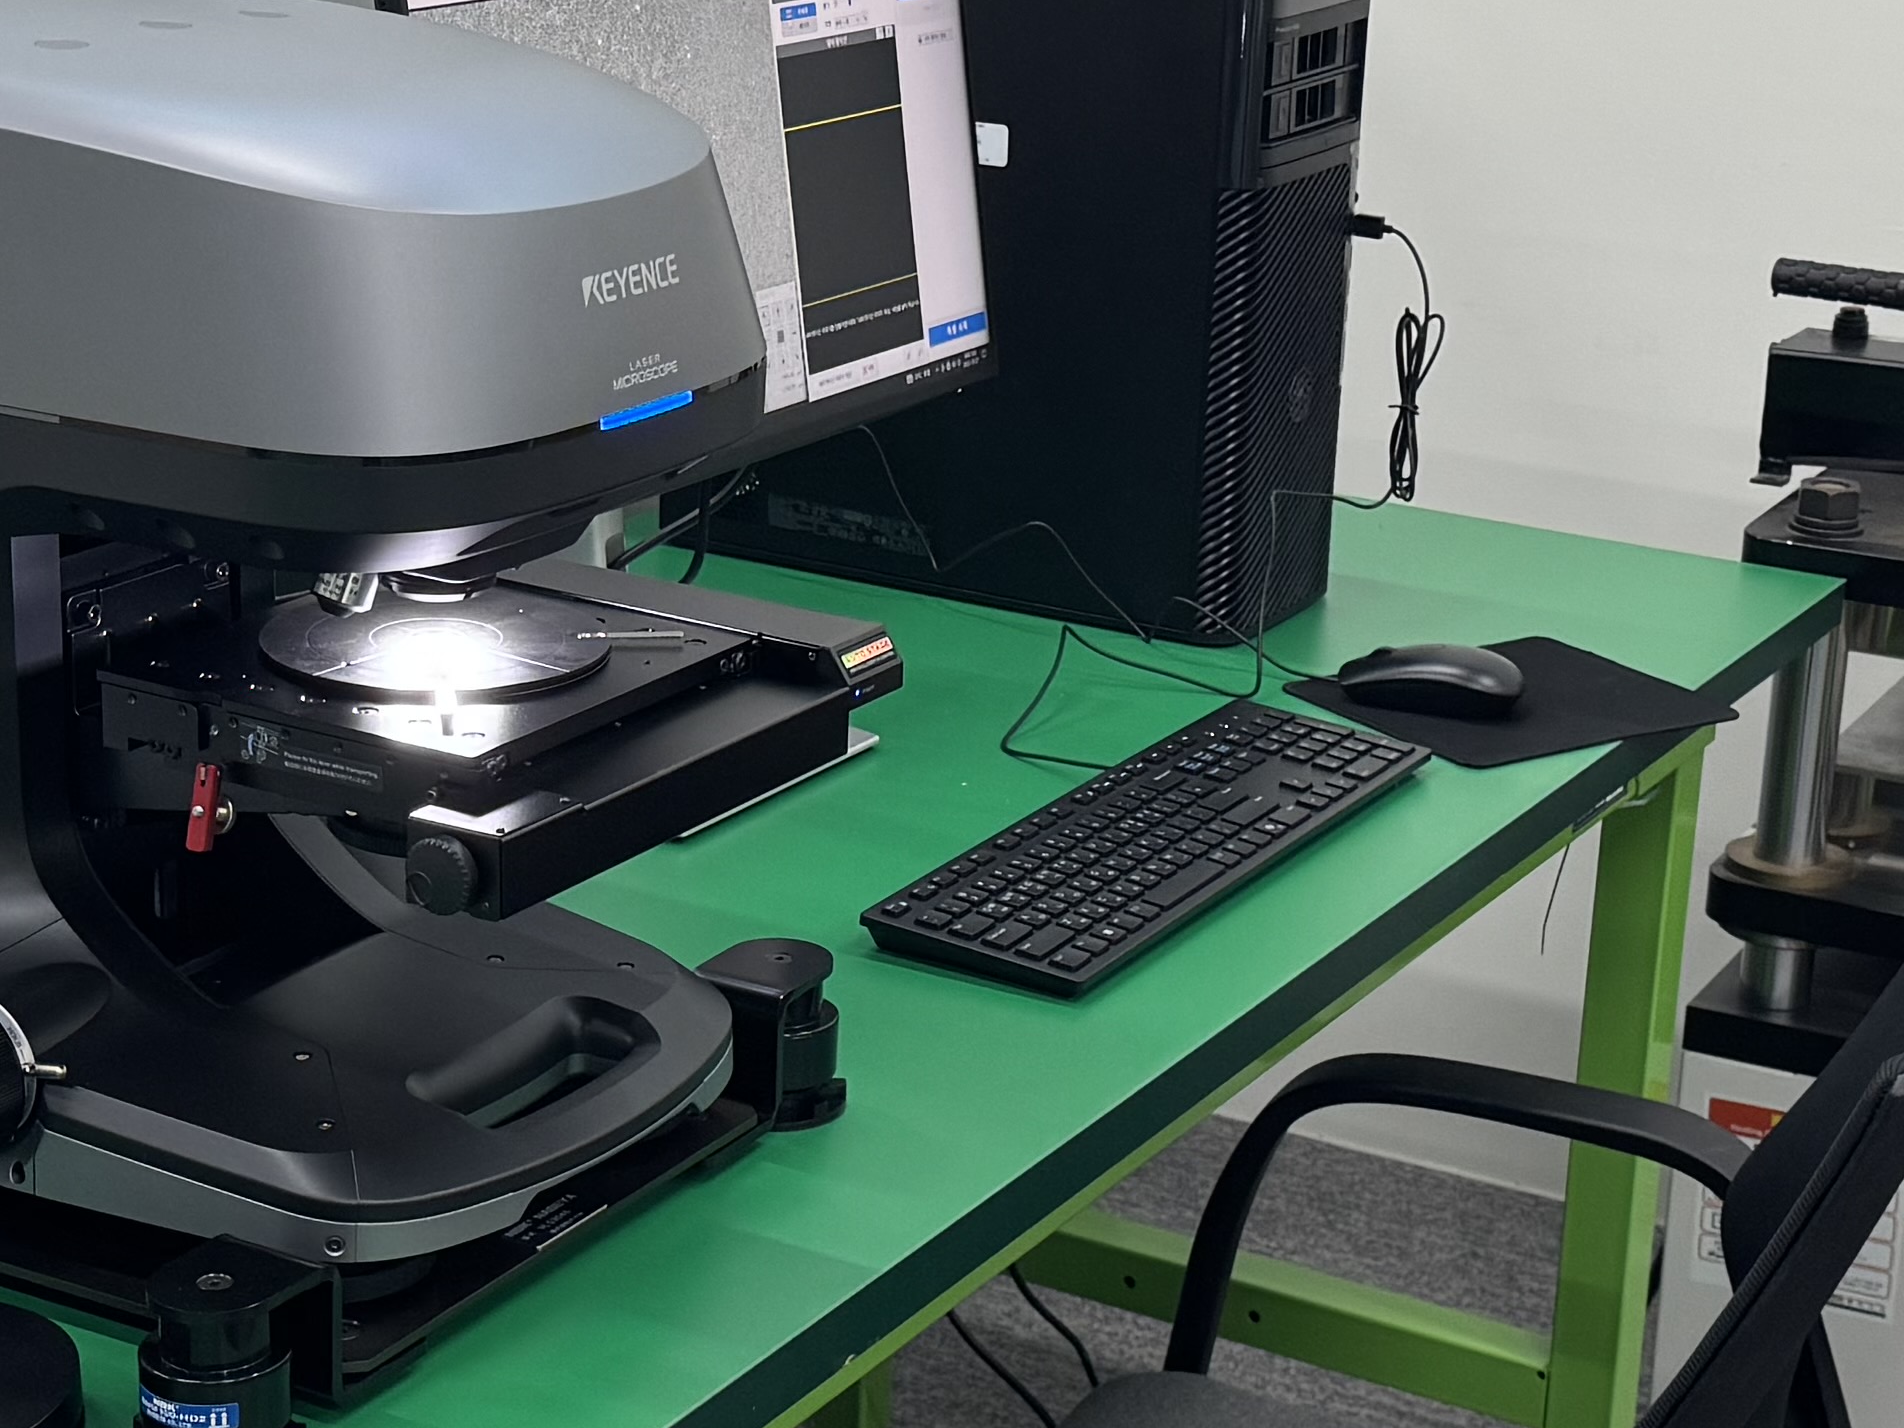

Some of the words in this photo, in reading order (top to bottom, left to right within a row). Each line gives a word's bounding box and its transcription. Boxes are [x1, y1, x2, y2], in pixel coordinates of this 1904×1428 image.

[582, 253, 680, 308] KEYENCE
[613, 360, 678, 390] MICROSCOPE
[629, 353, 660, 372] LASER
